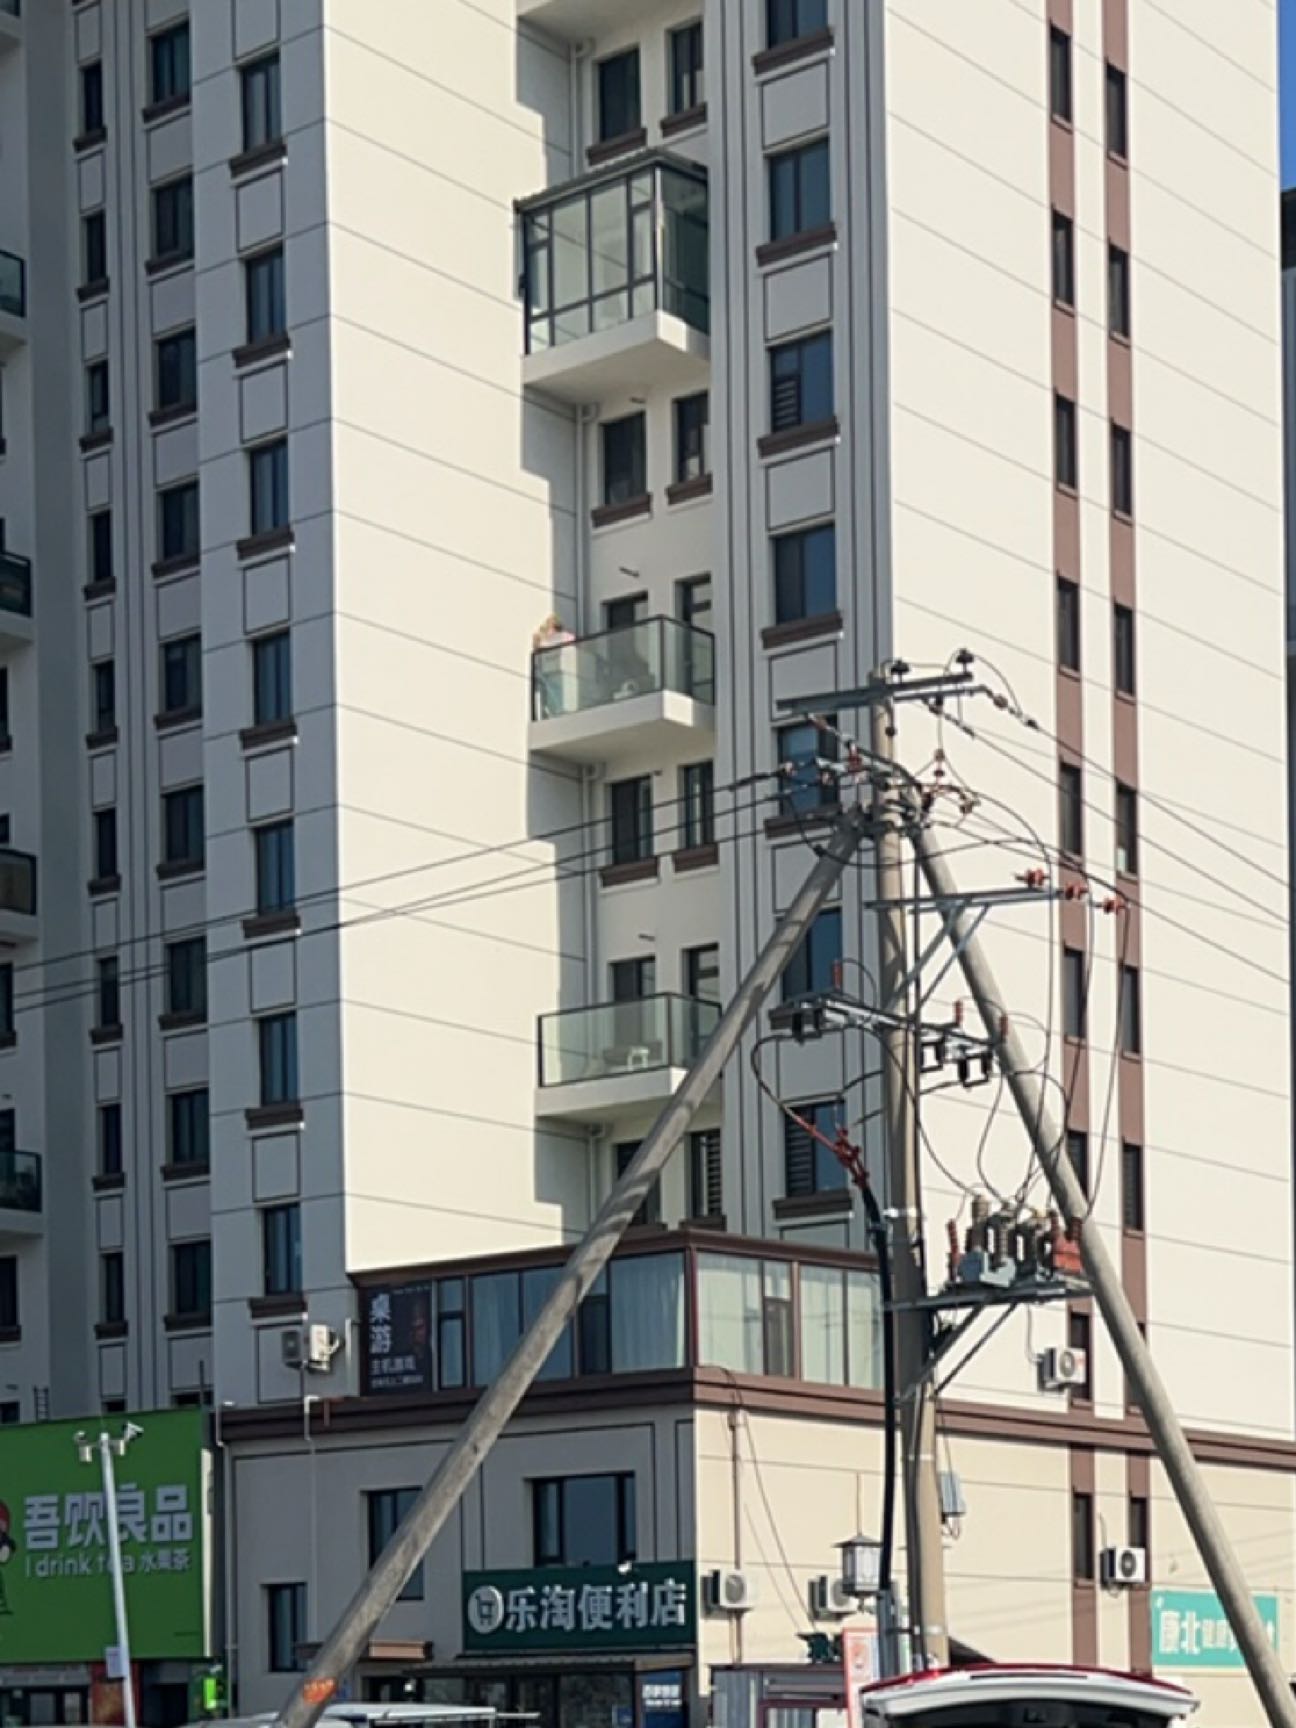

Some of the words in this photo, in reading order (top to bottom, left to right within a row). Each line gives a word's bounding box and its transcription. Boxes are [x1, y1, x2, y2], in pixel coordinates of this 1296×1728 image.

[24, 1482, 193, 1549] 吾饮良品
[35, 1554, 91, 1578] drink
[505, 1577, 687, 1633] 乐淘便利店
